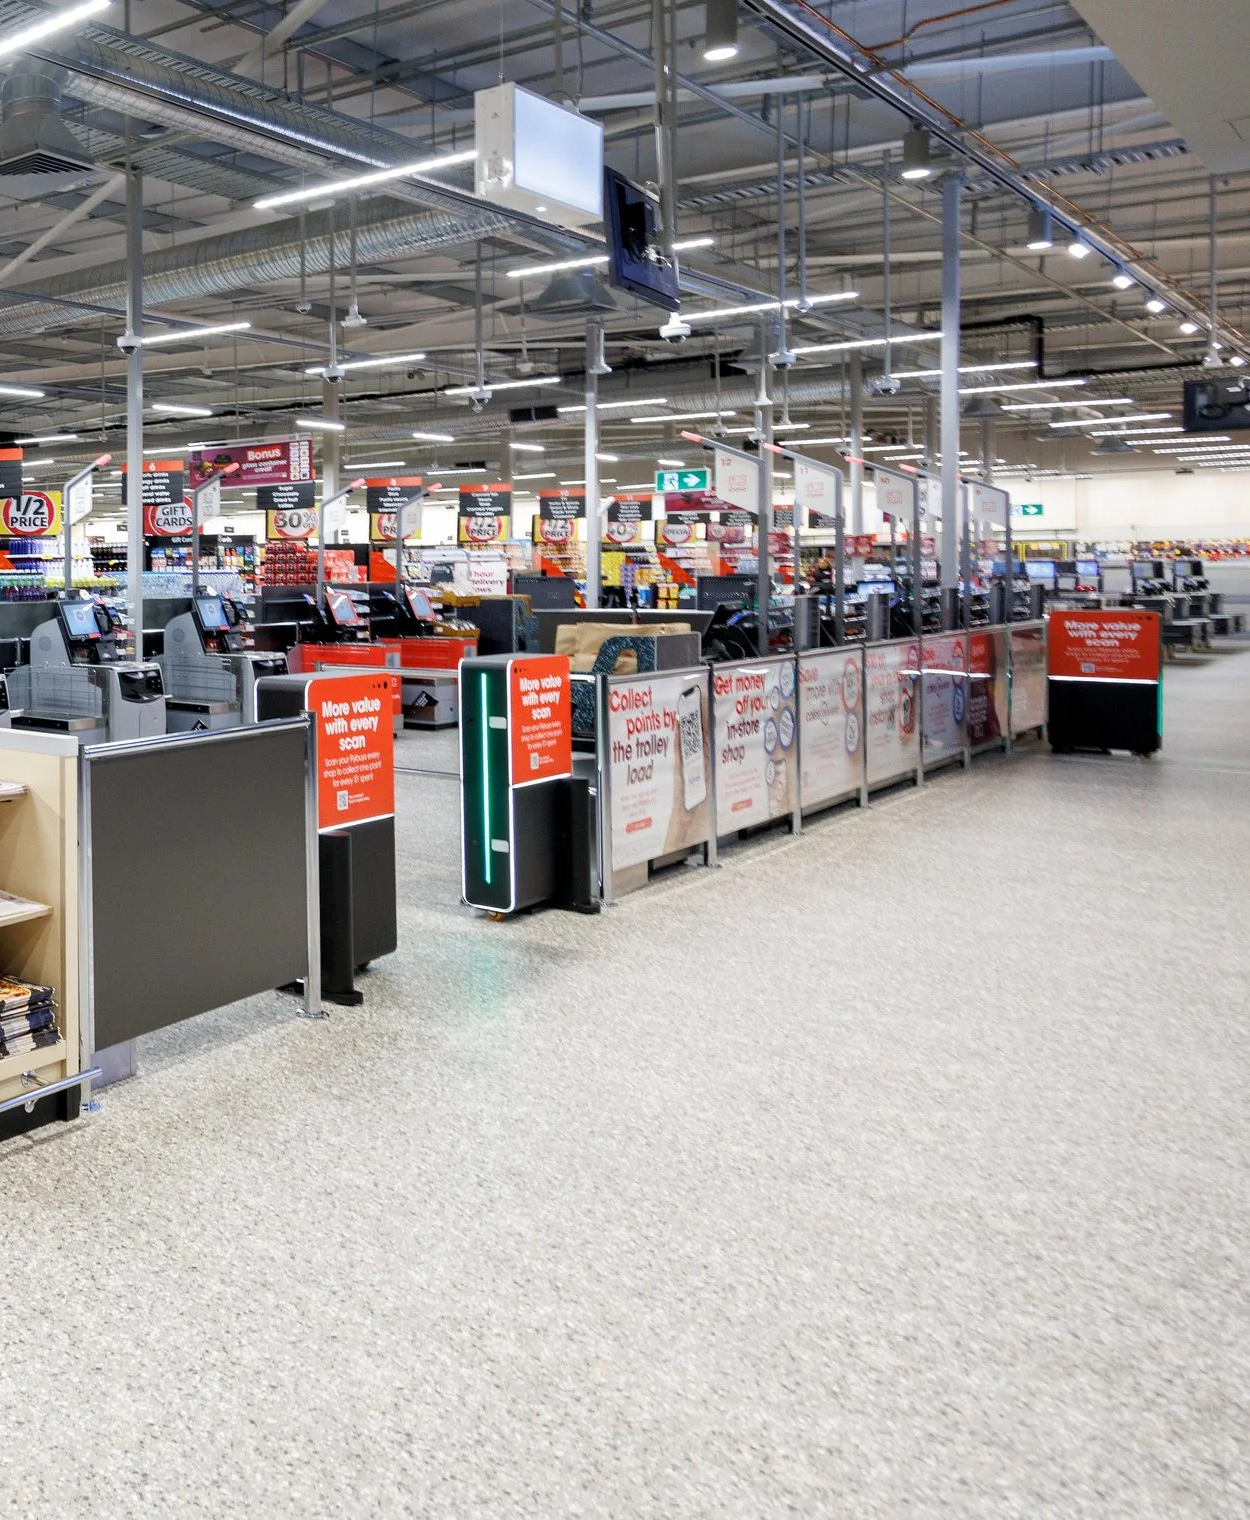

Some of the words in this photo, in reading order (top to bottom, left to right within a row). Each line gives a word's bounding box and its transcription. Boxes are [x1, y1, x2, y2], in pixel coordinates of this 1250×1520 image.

[247, 449, 281, 460] Bonus
[149, 462, 156, 471] 6
[12, 496, 45, 515] 1/2
[162, 507, 186, 516] GIFT
[10, 516, 47, 527] PRICE
[157, 517, 192, 526] CARDS
[276, 512, 317, 528] 30%
[1064, 620, 1099, 630] More
[1102, 621, 1141, 631] value
[1099, 630, 1138, 640] every
[519, 677, 540, 692] More
[540, 674, 562, 689] value
[715, 676, 733, 697] Get
[735, 673, 765, 692] money
[322, 701, 350, 718] More
[352, 696, 381, 713] value
[522, 692, 539, 707] with
[539, 691, 560, 705] every
[609, 687, 652, 712] Collect
[736, 699, 750, 716] off
[750, 696, 769, 717] your
[532, 707, 551, 720] scan
[325, 718, 348, 735] with
[350, 716, 378, 732] every
[626, 711, 660, 740] points
[663, 708, 676, 732] by
[726, 720, 759, 740] in-store
[339, 735, 366, 751] scan
[613, 740, 632, 763] the
[635, 735, 669, 760] trolley
[325, 758, 338, 767] Scan
[339, 756, 349, 766] your
[368, 752, 380, 760] every
[721, 744, 745, 764] shop
[323, 769, 336, 779] shop
[342, 765, 359, 774] collect
[369, 762, 382, 770] point
[626, 761, 654, 786] load
